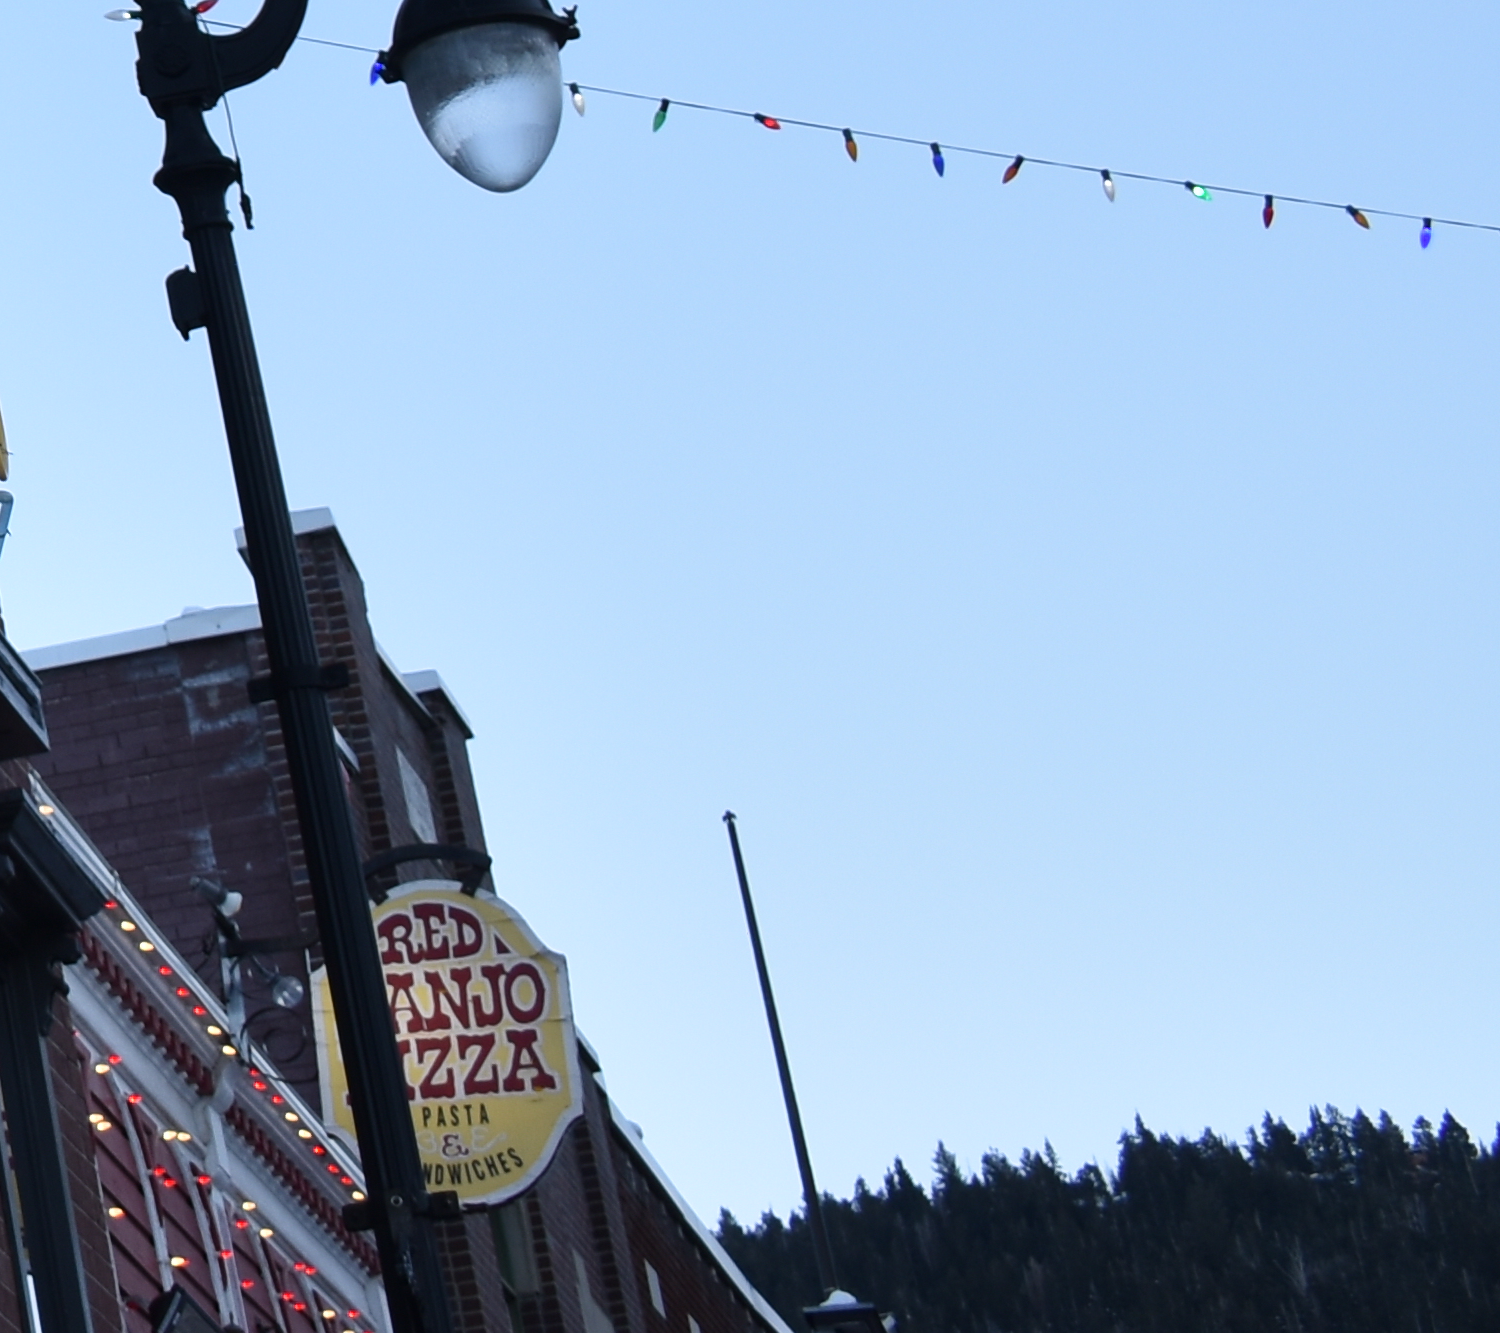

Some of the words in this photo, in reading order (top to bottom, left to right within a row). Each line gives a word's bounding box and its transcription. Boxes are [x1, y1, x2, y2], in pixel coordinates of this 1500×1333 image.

[377, 902, 483, 965] RED
[385, 962, 546, 1033] ANJO
[396, 1029, 556, 1102] ZZA
[422, 1103, 490, 1128] PASTA
[422, 1147, 524, 1186] NDWICHES
[441, 1134, 470, 1157] &
